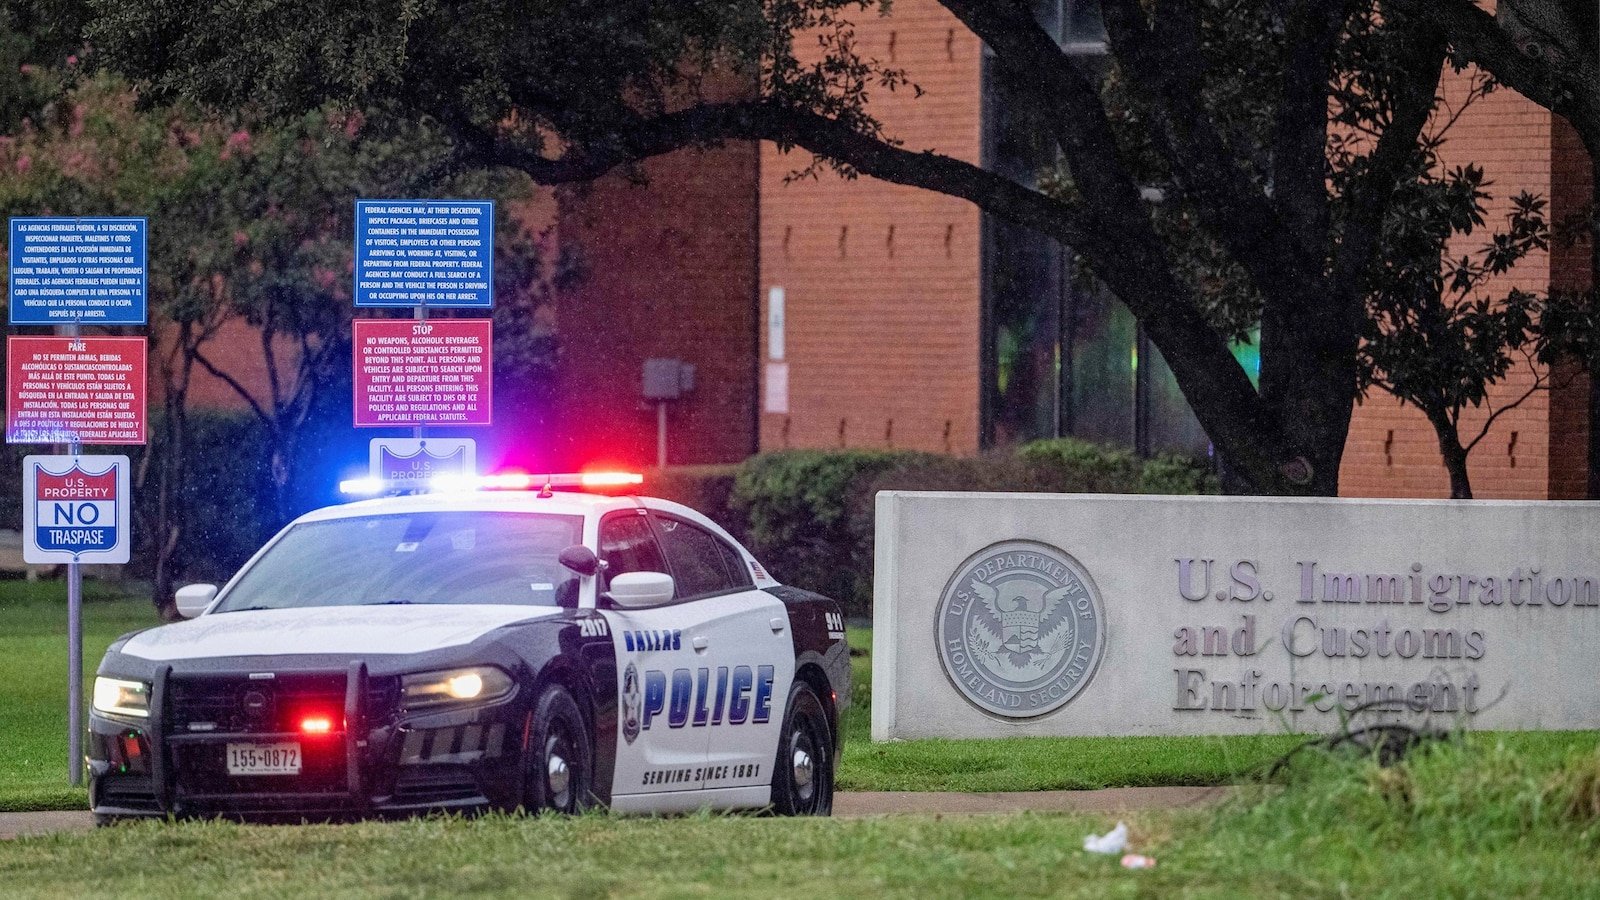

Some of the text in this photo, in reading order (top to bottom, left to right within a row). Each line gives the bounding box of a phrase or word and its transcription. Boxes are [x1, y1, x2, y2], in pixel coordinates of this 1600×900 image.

[413, 326, 432, 334] STOP
[68, 343, 86, 351] PARE
[391, 470, 449, 480] PROPE
[412, 462, 434, 470] U.S.
[44, 488, 108, 497] PROPERTY
[65, 478, 88, 487] U.S.
[54, 502, 99, 525] NO
[49, 530, 104, 544] TRASPASE
[950, 554, 1093, 621] U.S. DEPARTMENT OF
[1174, 558, 1600, 613] U.S. Immigration
[578, 619, 608, 636] 2017
[1172, 615, 1486, 660] and Customs
[624, 629, 681, 652] DALLAS
[948, 638, 1092, 708] HOMELAND SECURITY
[642, 665, 774, 730] POLICE
[1173, 668, 1480, 713] Enforcement
[642, 764, 760, 784] SERVING SINCE 1881
